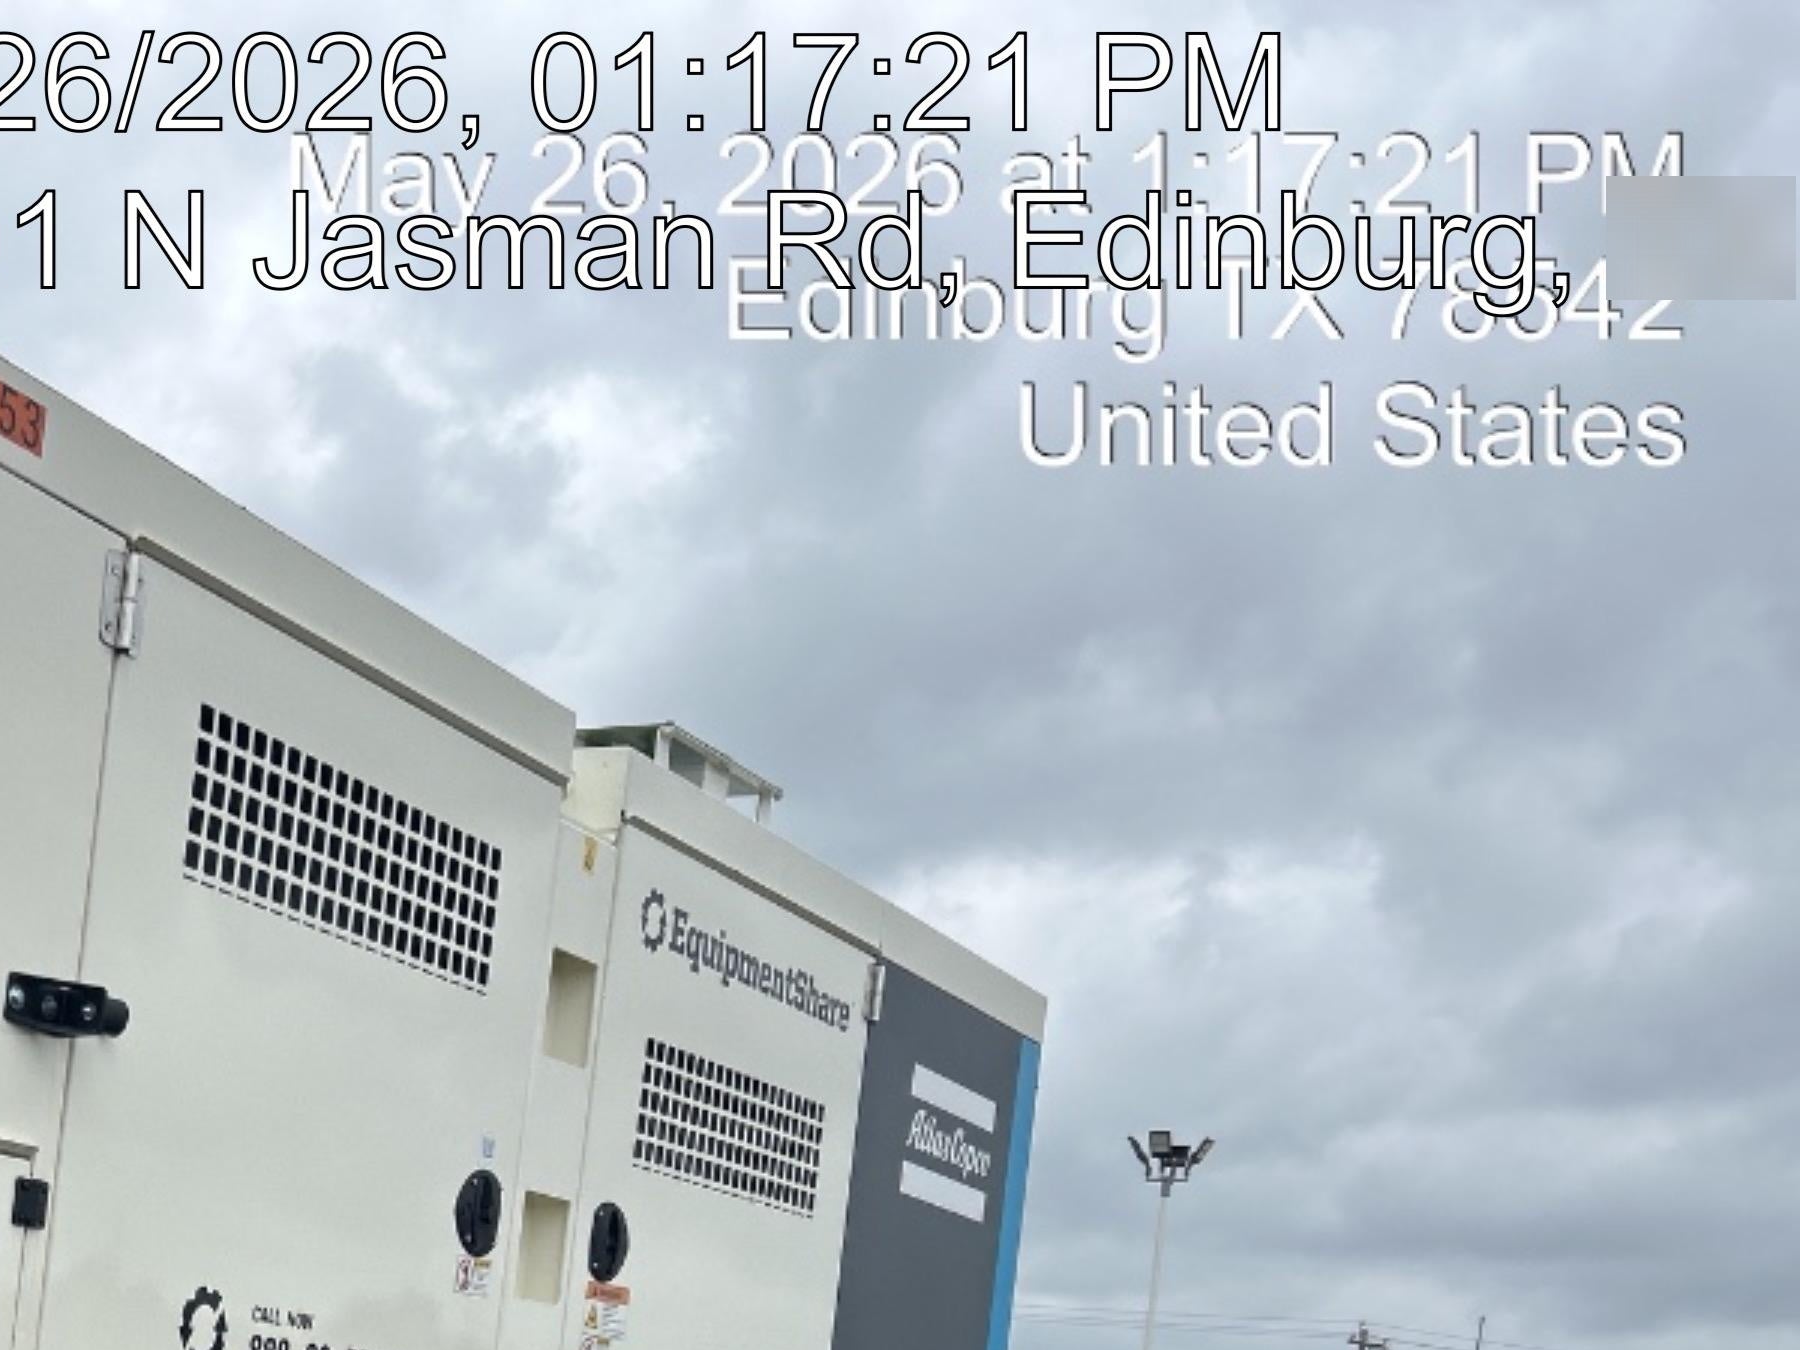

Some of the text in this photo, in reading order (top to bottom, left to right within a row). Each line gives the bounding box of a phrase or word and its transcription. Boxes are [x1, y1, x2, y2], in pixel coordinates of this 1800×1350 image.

[668, 905, 851, 1033] EquipmentShare
[251, 1304, 316, 1331] CALL NOW
